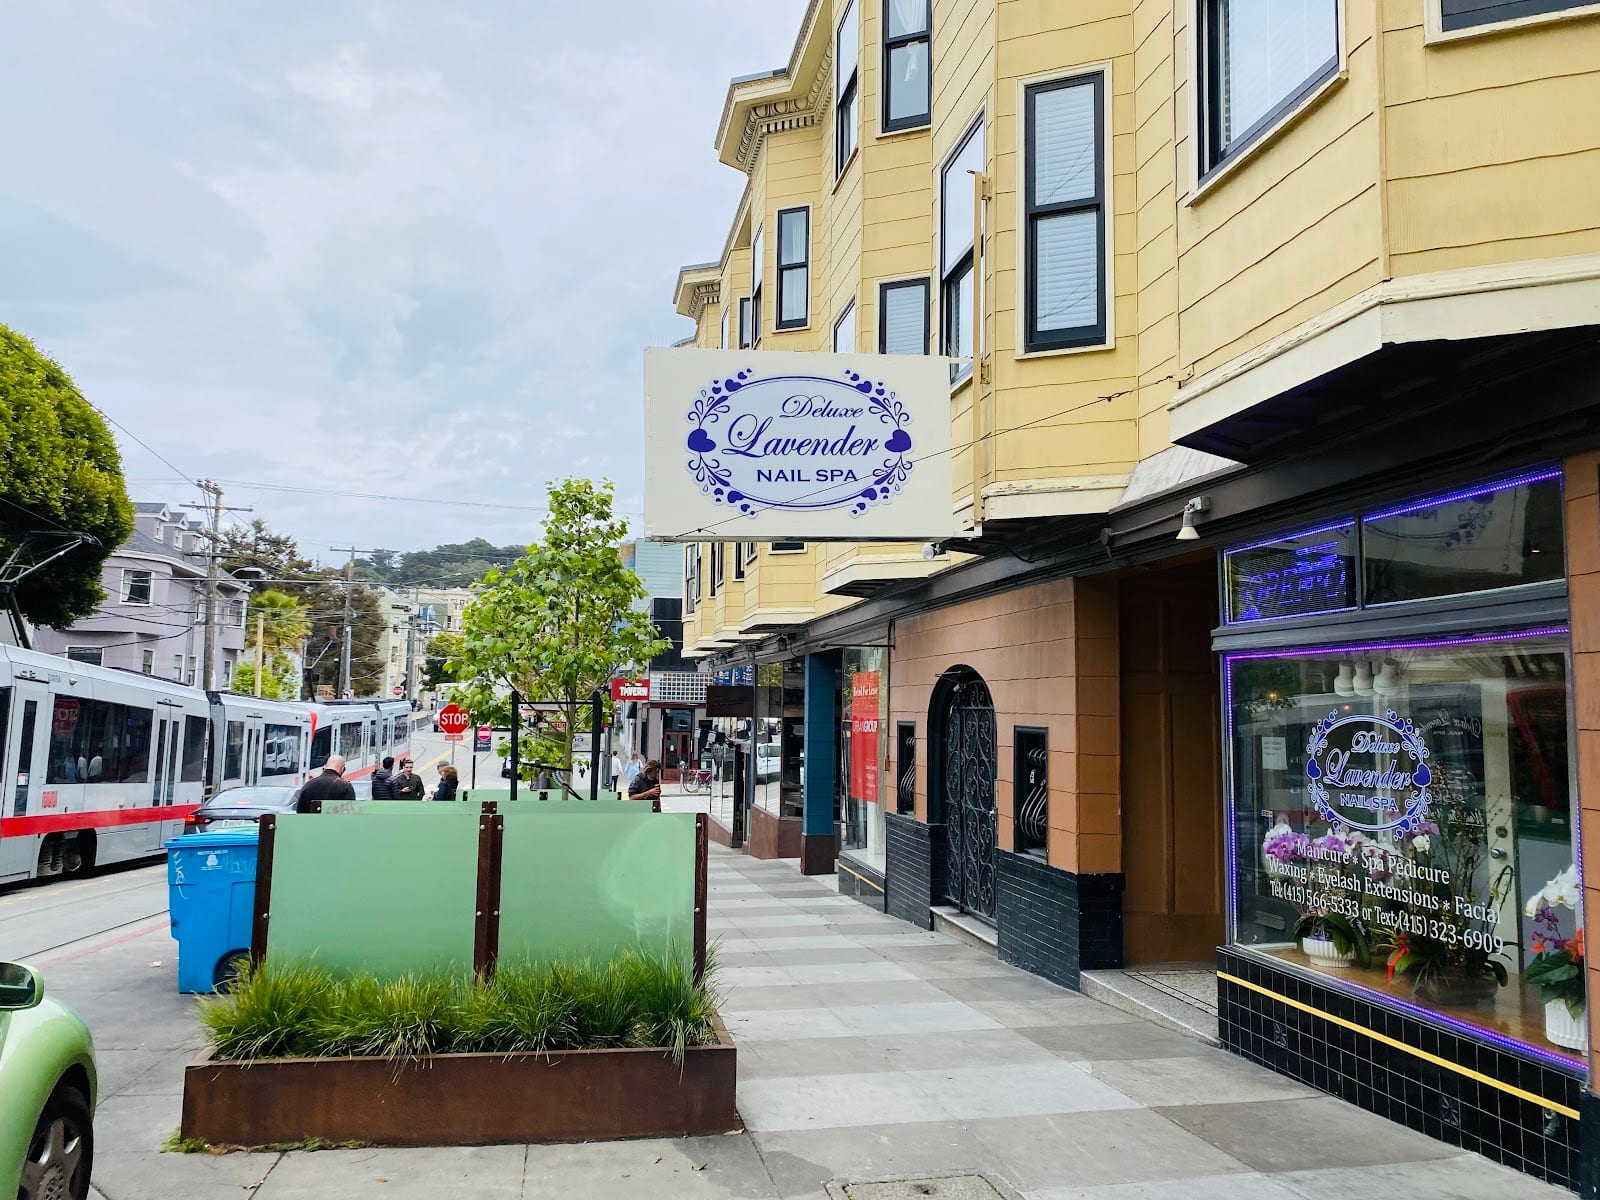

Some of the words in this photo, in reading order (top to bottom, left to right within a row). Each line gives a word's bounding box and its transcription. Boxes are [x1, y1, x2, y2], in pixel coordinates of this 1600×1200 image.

[779, 394, 864, 418] Deluxe
[721, 413, 880, 458] Lavender
[757, 469, 811, 482] NAIL
[816, 469, 858, 482] SPA
[619, 686, 648, 696] TAVERN
[441, 713, 468, 725] STOP
[1351, 731, 1400, 754] Deluxe
[1323, 748, 1411, 790] Lavender
[1340, 793, 1370, 809] NAIL
[1371, 797, 1399, 811] SPA
[1297, 839, 1350, 864] Manicure
[1361, 852, 1384, 874] Spa
[1388, 856, 1450, 885] Pedicure
[1268, 856, 1308, 883] Waxing
[1318, 867, 1361, 892] Eyelash
[1364, 877, 1439, 910] Extensions
[1455, 895, 1501, 924] Facial
[1306, 890, 1359, 918] 566-5333
[1362, 907, 1372, 921] or
[1398, 910, 1428, 937] (415)
[1430, 920, 1504, 955] 323-6909
